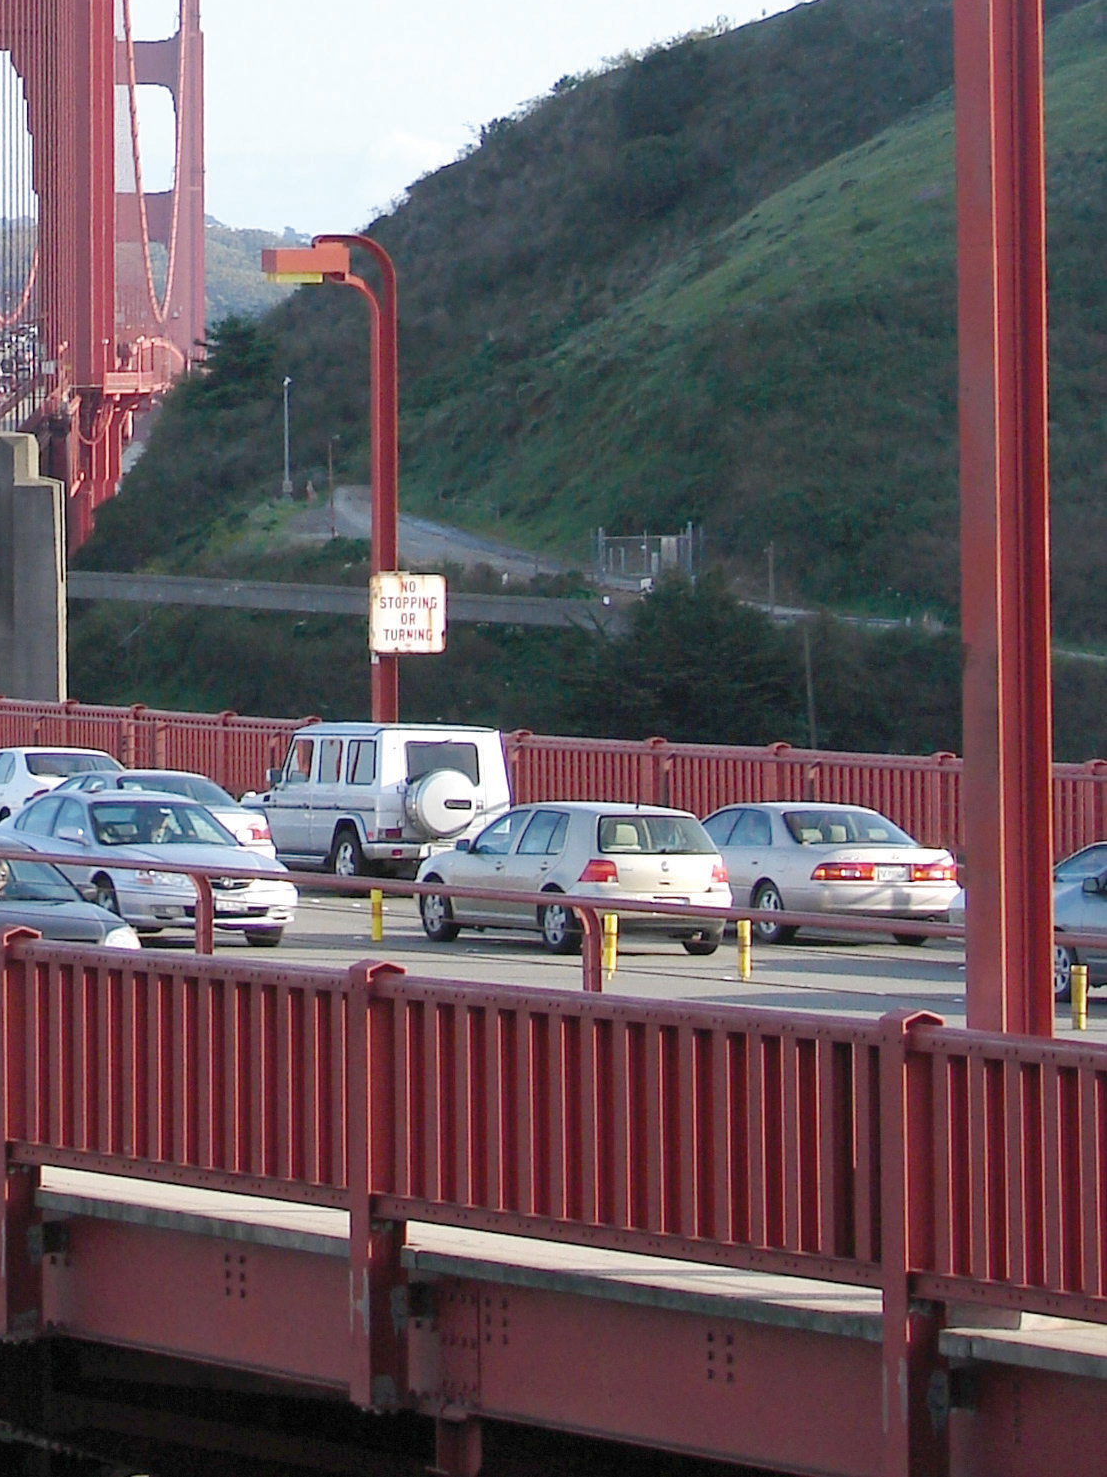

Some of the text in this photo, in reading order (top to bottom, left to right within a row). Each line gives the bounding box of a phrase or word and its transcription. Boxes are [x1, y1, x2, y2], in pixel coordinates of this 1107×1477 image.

[400, 580, 416, 593] NO
[379, 596, 438, 610] STOPPING
[400, 612, 416, 625] OR
[383, 629, 433, 641] TURNING
